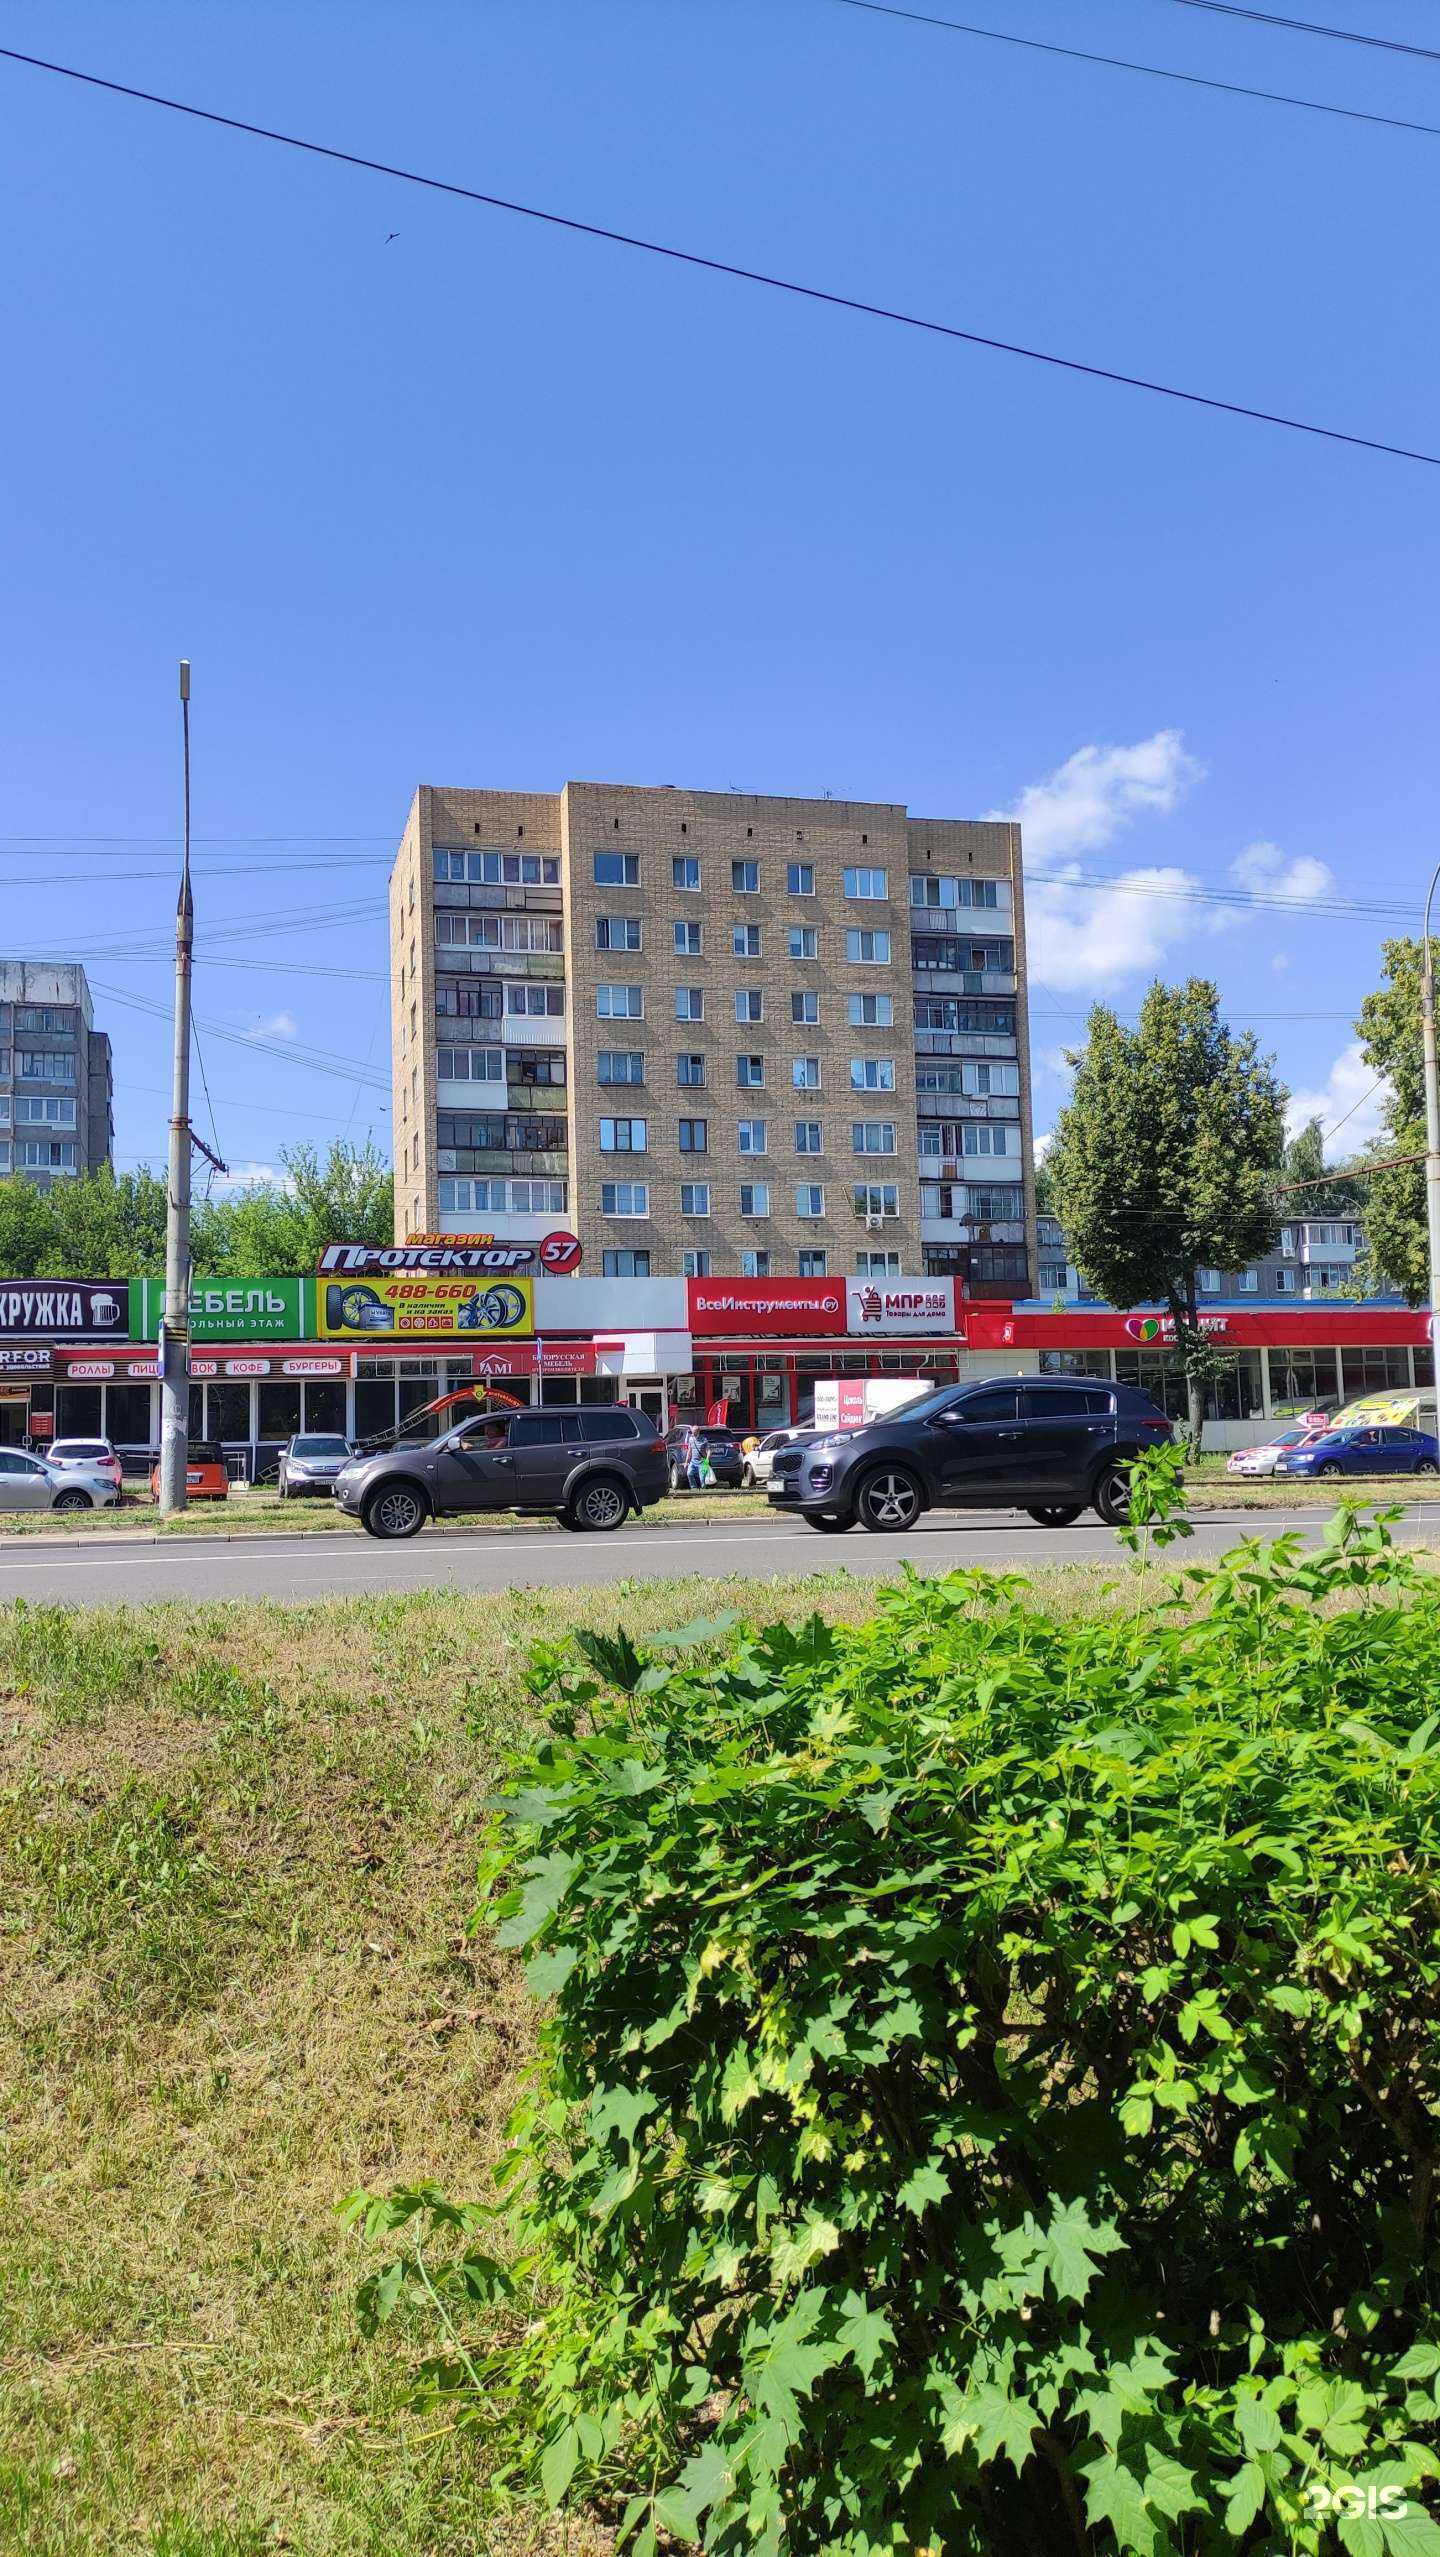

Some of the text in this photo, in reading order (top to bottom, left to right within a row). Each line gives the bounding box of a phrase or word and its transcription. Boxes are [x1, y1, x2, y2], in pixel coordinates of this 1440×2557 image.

[406, 1233, 495, 1246] магазин
[543, 1242, 575, 1262] 57
[384, 1284, 477, 1299] 488-660
[160, 1290, 286, 1313] ЕБЕЛЬ
[885, 1294, 924, 1309] МПР
[250, 1318, 285, 1328] ЭТАЖ
[71, 1365, 111, 1375] РОЛЛЫ
[233, 1363, 264, 1373] КОФЕ
[289, 1360, 337, 1371] БУРГЕРЫ
